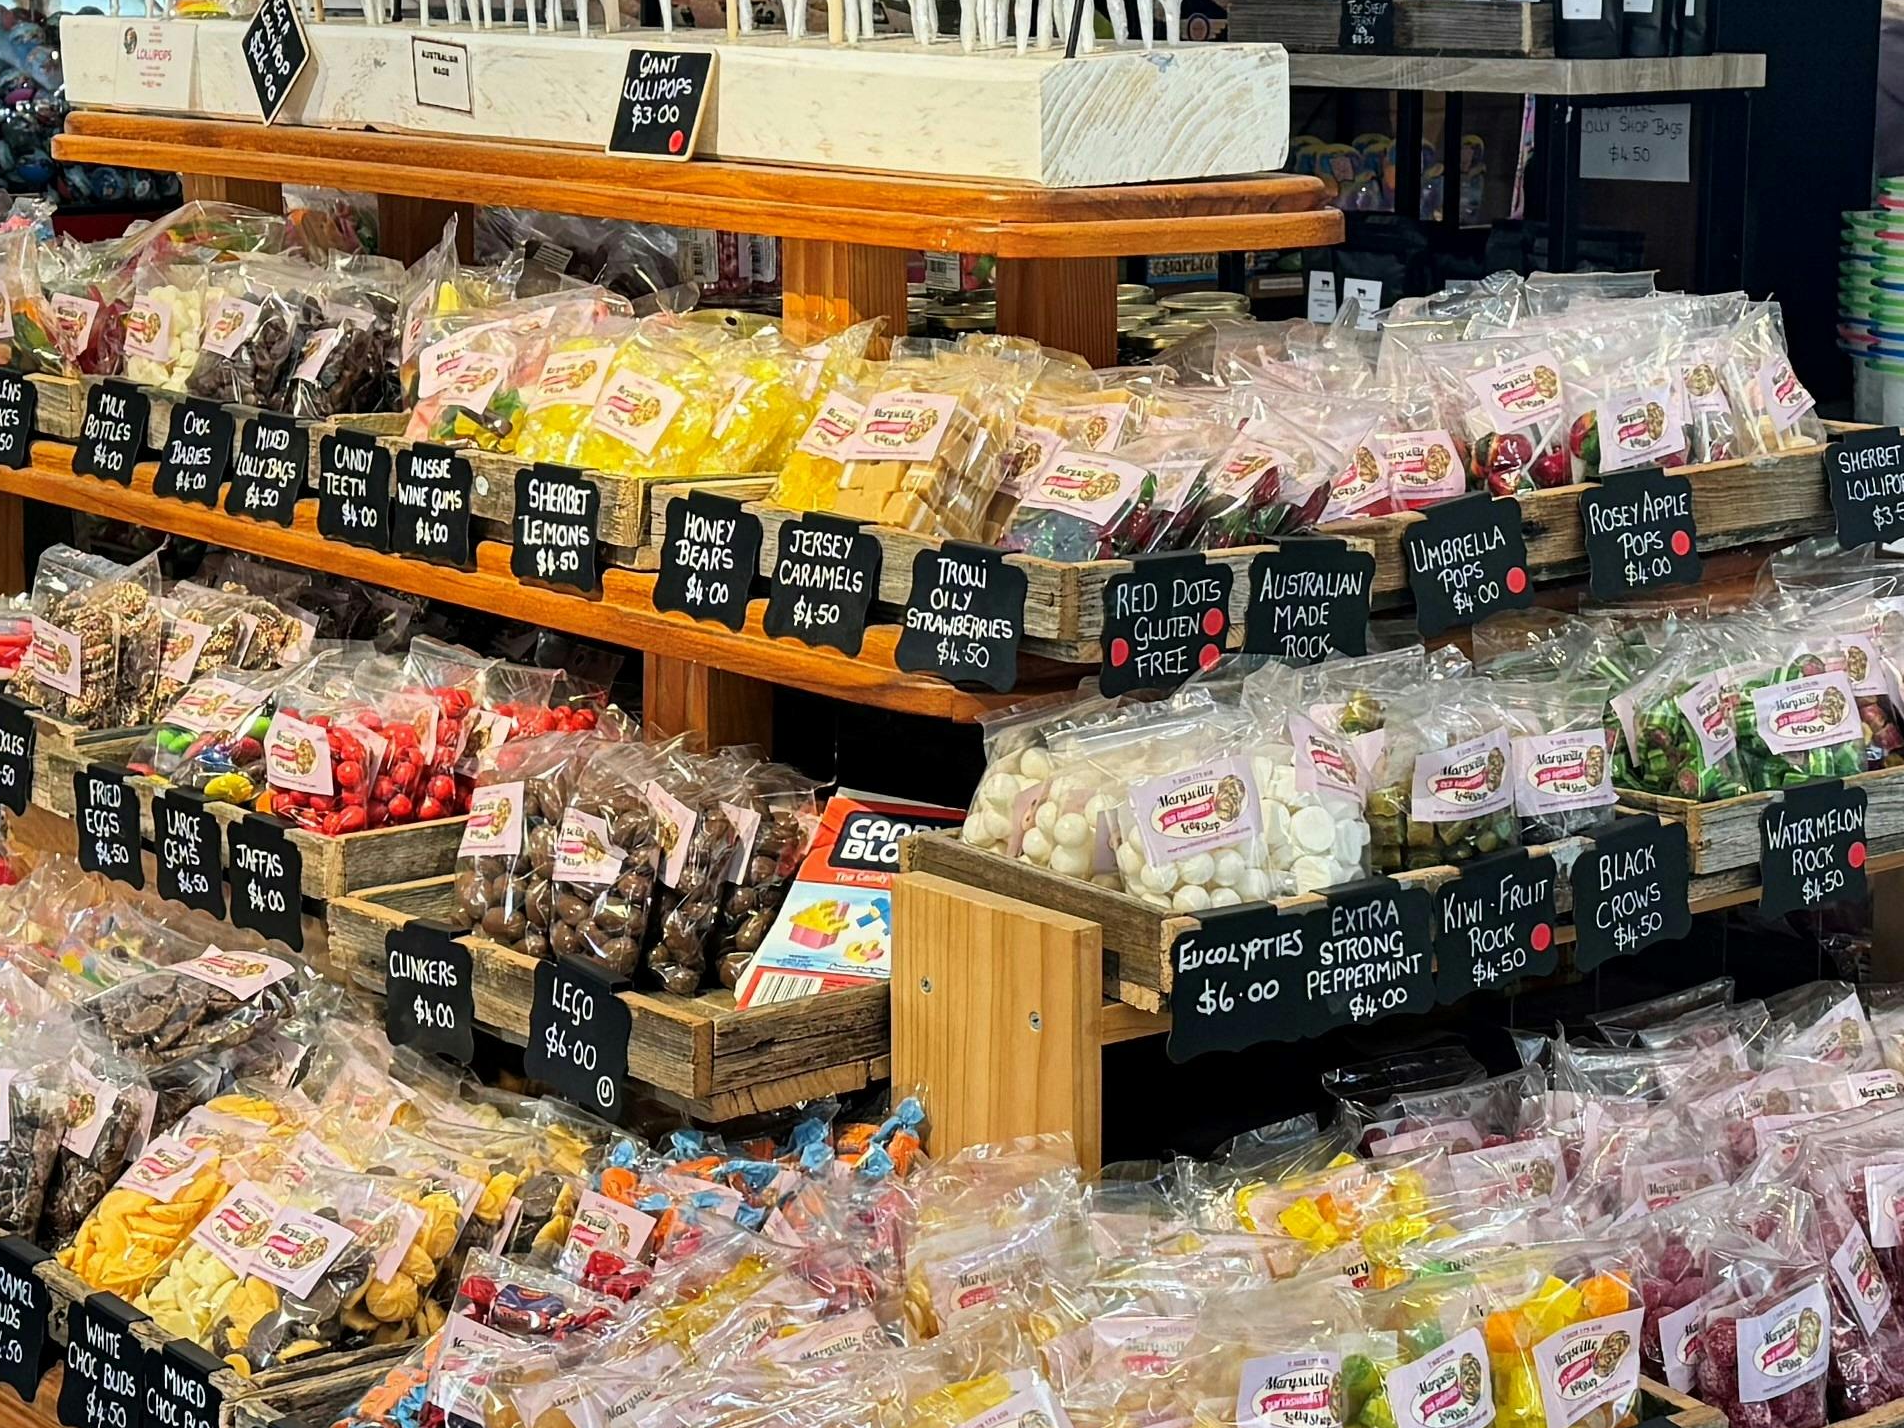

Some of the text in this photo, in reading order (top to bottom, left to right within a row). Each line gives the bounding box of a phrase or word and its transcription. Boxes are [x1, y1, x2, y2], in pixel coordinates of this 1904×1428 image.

[421, 49, 459, 64] AUSTRALIAN
[622, 75, 693, 103] LOLLIPOPS
[1619, 115, 1683, 140] SHOP BAGS
[99, 393, 127, 420] MILK
[84, 414, 131, 442] BOTTLES
[169, 440, 212, 465] BABIES
[333, 447, 374, 473] CANDY
[409, 456, 451, 480] AUSSIE
[1838, 445, 1902, 475] SHERBET
[322, 472, 367, 498] TEETH
[397, 482, 464, 516] WINE GUMS
[527, 481, 591, 516] SHERBET
[683, 514, 736, 545] HONEY
[1589, 490, 1690, 535] ROSEY APPLE
[522, 516, 589, 548] LEMONS
[788, 530, 854, 559] JERSEY
[1617, 532, 1665, 561] POPS
[675, 541, 735, 573] BEARS
[1410, 526, 1507, 574] UMBRELLA
[778, 560, 864, 594] CARAMELS
[1259, 569, 1364, 605] AUSTRALIAN
[1437, 562, 1485, 597] POPS
[929, 588, 973, 613] OILY
[1116, 577, 1223, 620] RED DOTS
[905, 606, 1014, 641] STRAWBERRIES
[1134, 610, 1201, 654] GLUTEN
[1274, 602, 1330, 635] MADE
[1137, 648, 1190, 679] FREE
[89, 779, 122, 807] FRIED
[84, 807, 120, 836] EGGS
[167, 808, 204, 845] LARGE
[1766, 803, 1864, 852] WATERMELON
[163, 838, 202, 871] GEMS
[236, 843, 284, 878] JAFFAS
[1598, 845, 1658, 892] BLACK
[1791, 844, 1834, 876] ROCK
[834, 872, 889, 883] The Candy
[1331, 900, 1399, 935] EXTRA
[1595, 882, 1662, 930] CROWS
[1178, 928, 1304, 974] EUCOLYPTIES
[1319, 932, 1404, 967] STRONG
[1466, 920, 1515, 956] ROCK
[389, 950, 458, 987] CLINKERS
[1305, 952, 1422, 1000] PEPPERMINT
[551, 978, 596, 1027] LEGO
[85, 1313, 122, 1360] WHITE
[68, 1341, 137, 1398] CHOC BUDS
[163, 1363, 207, 1409] MIXED
[146, 1386, 180, 1428] CHOC
